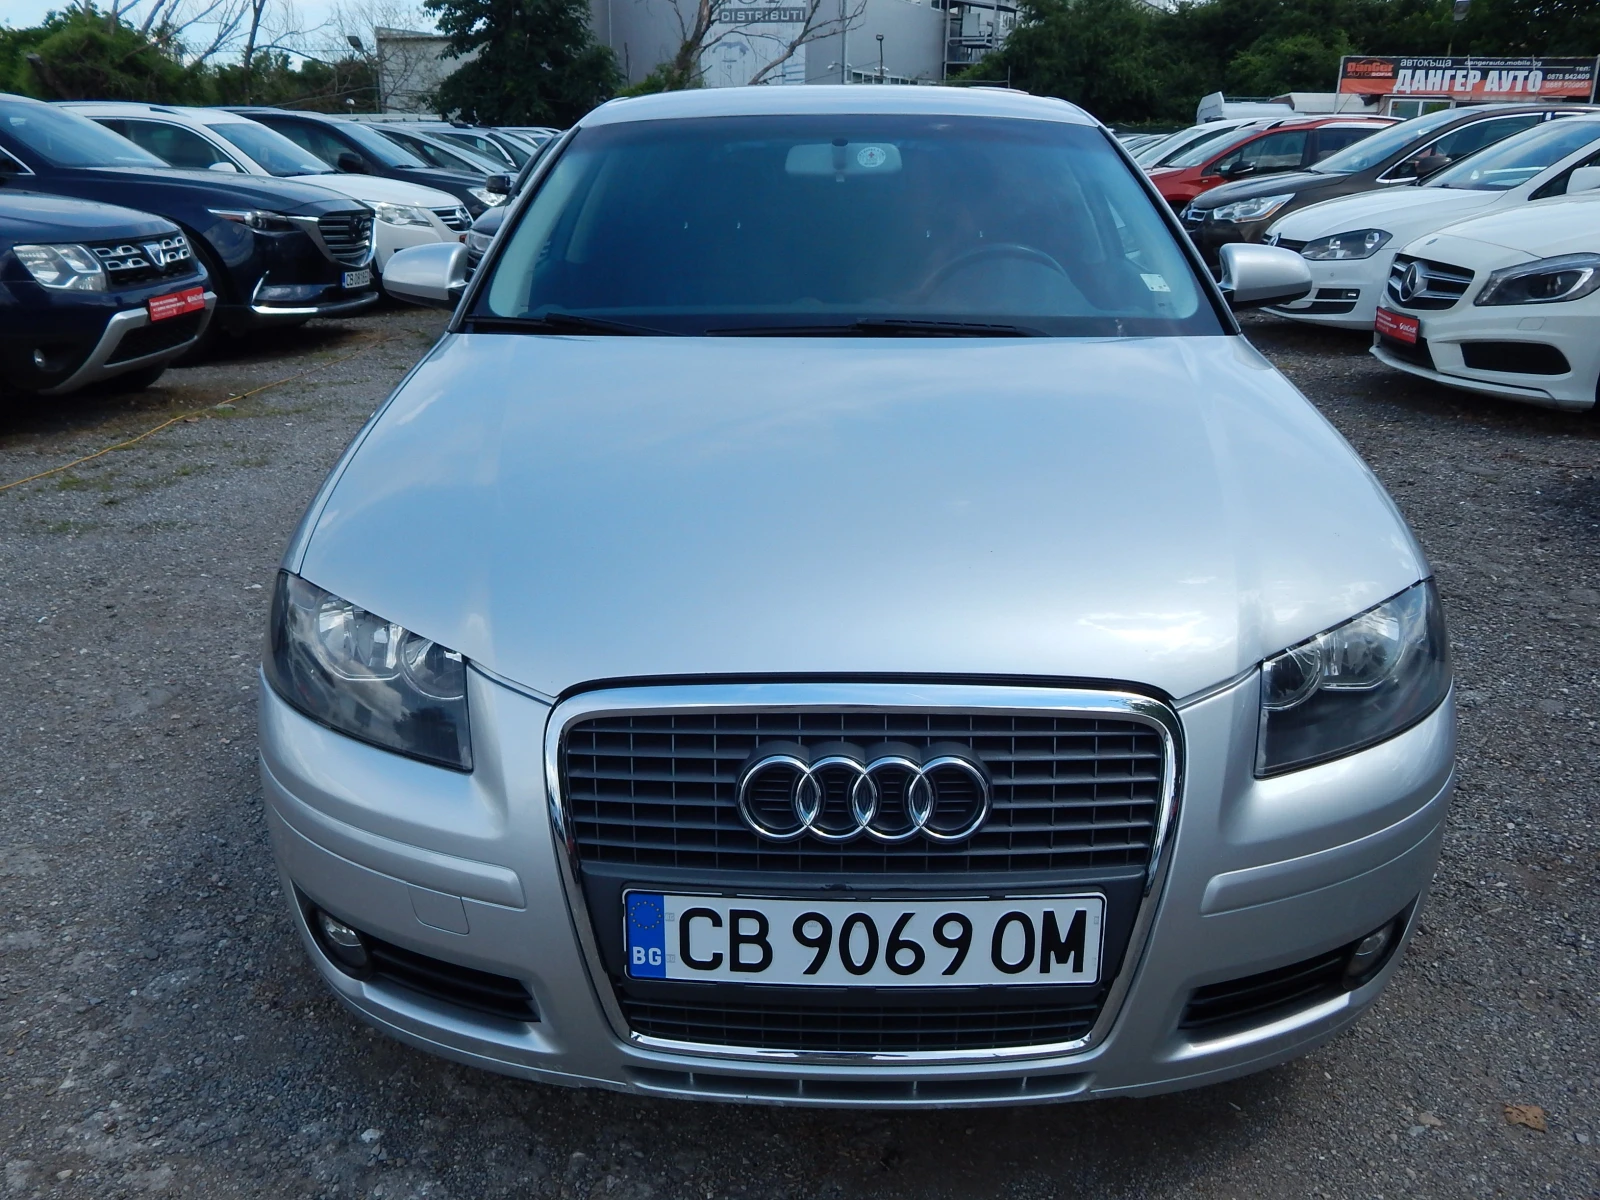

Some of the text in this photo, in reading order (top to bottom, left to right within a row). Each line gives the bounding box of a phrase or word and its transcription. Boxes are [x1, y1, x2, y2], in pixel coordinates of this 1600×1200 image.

[721, 11, 803, 21] DISTRIBUTI
[1347, 62, 1394, 72] DanGer
[1400, 58, 1452, 68] автокъща
[1392, 69, 1543, 94] ДАНГЕР АУТО
[678, 907, 1088, 976] CB 9069 OM
[632, 946, 662, 966] BG
